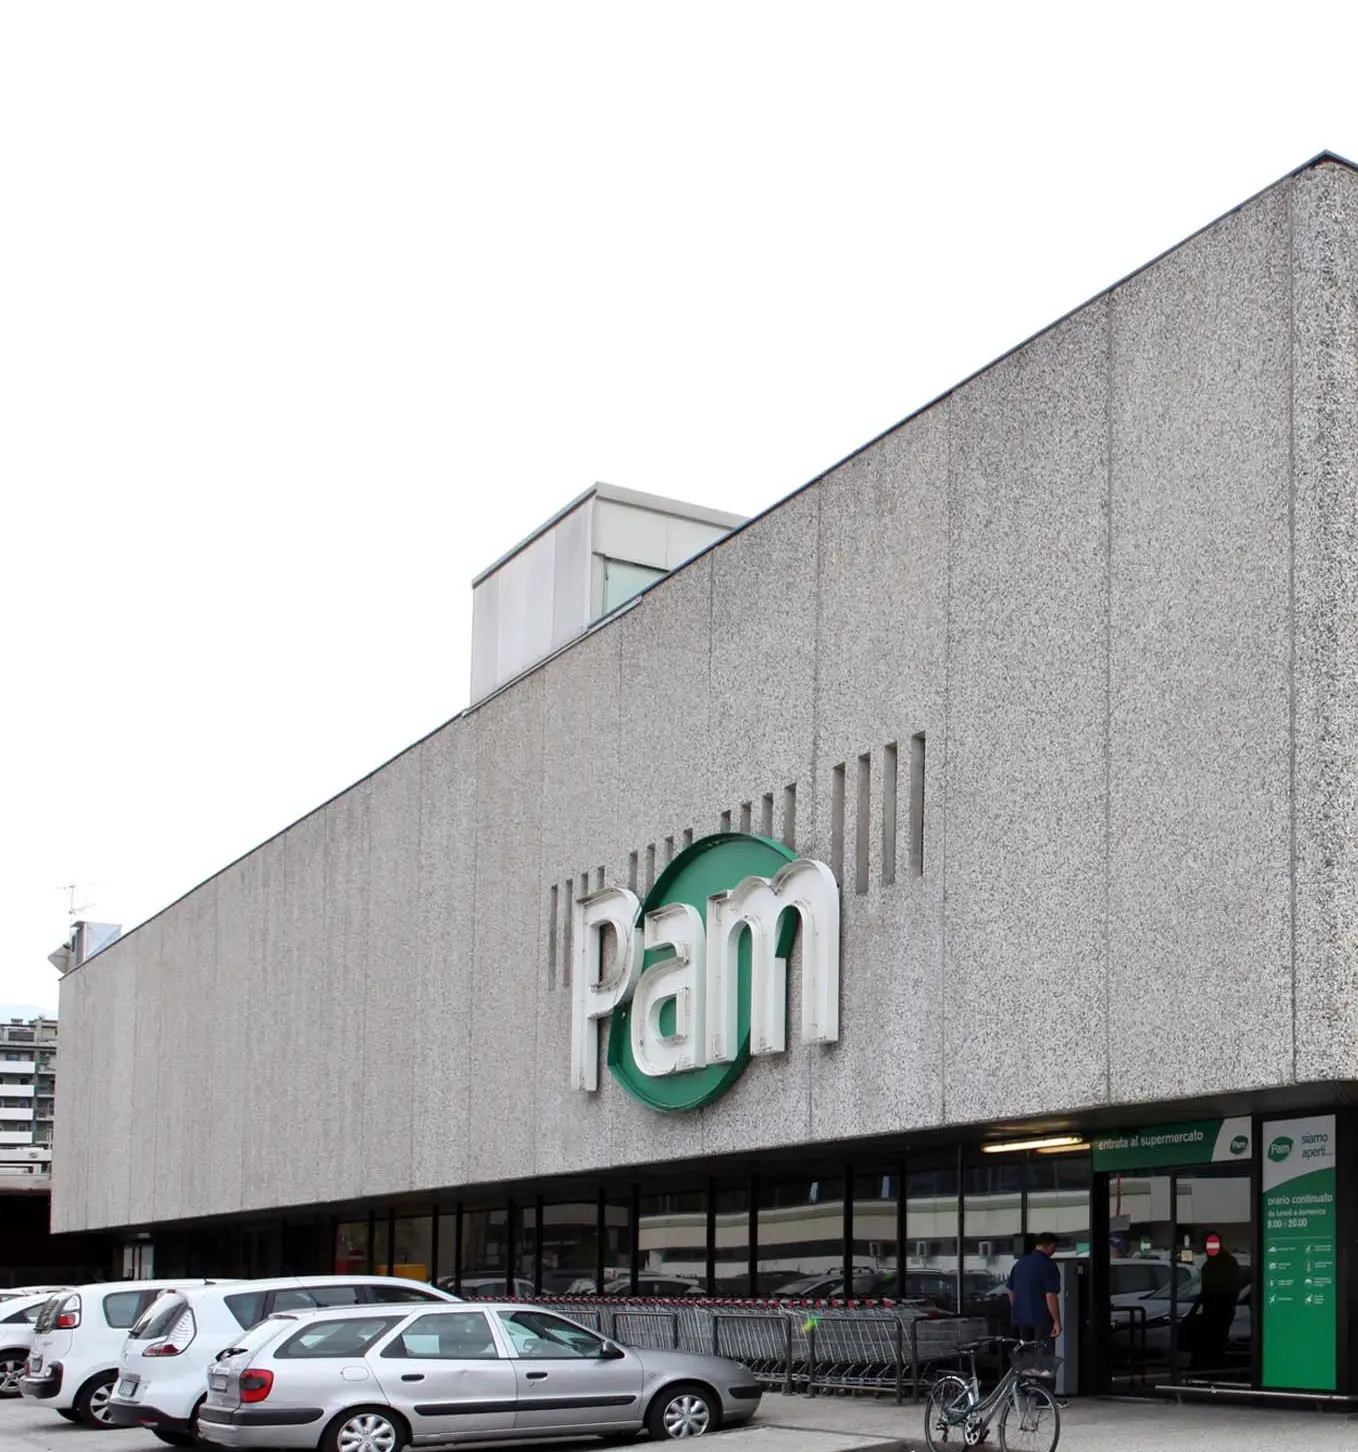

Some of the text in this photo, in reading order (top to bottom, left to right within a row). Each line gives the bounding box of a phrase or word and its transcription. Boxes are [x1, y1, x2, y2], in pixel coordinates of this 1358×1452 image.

[571, 858, 840, 1092] Pam
[1098, 1129, 1203, 1150] entrata al supermercato
[1301, 1132, 1328, 1144] siamo
[1271, 1143, 1290, 1154] Pam
[1267, 1193, 1333, 1205] orario continuato
